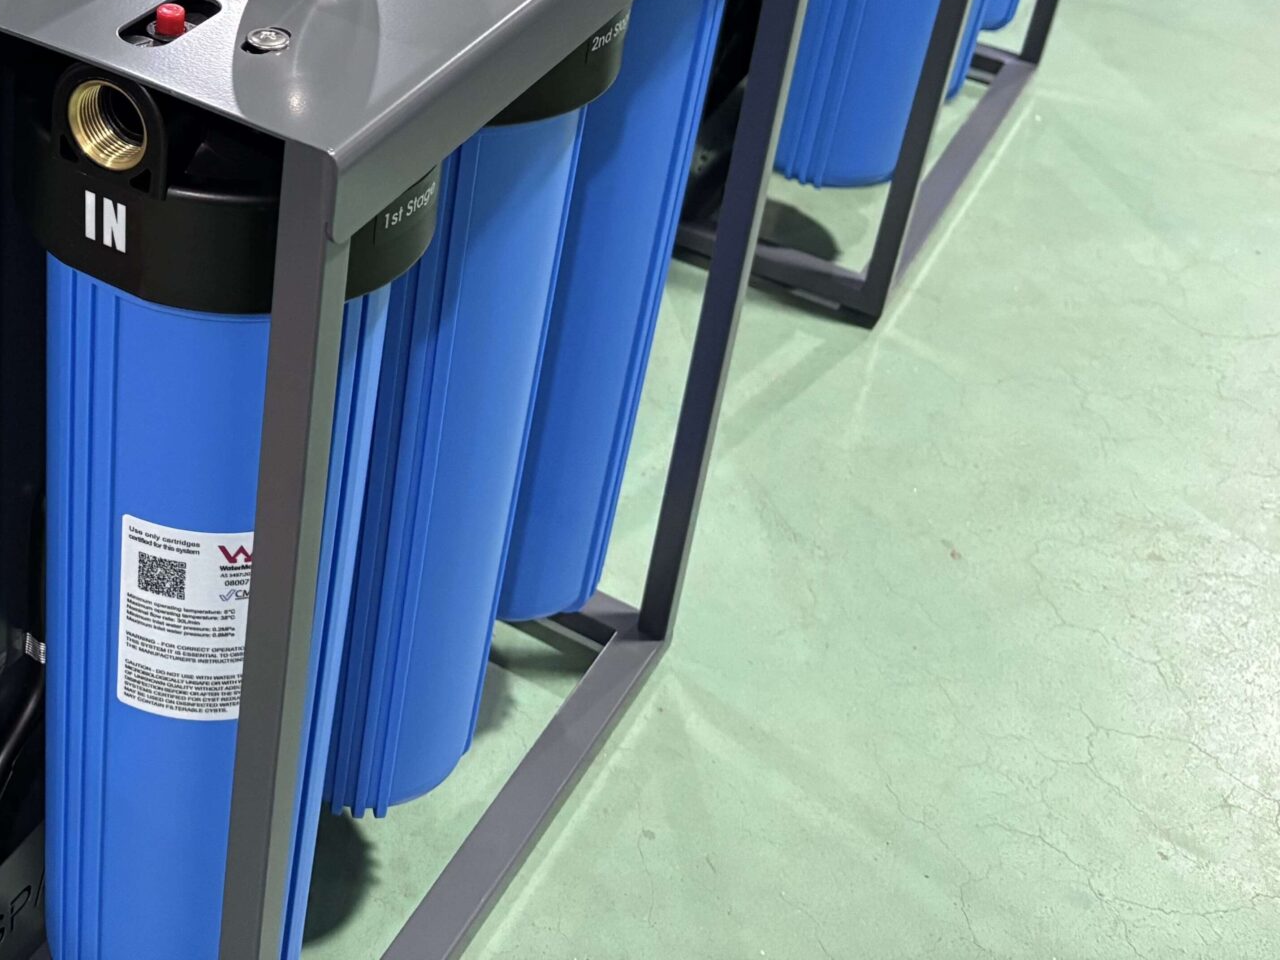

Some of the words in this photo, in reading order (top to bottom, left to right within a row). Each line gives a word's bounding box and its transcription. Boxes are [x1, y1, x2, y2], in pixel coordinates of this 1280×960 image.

[591, 26, 613, 52] 2nd
[385, 205, 404, 229] 1st
[406, 181, 436, 217] Stage
[84, 189, 127, 253] IN
[128, 525, 143, 536] Use
[144, 532, 160, 541] only
[162, 537, 200, 548] cartridges
[128, 534, 153, 546] certified
[175, 547, 200, 556] system
[235, 590, 250, 598] CM
